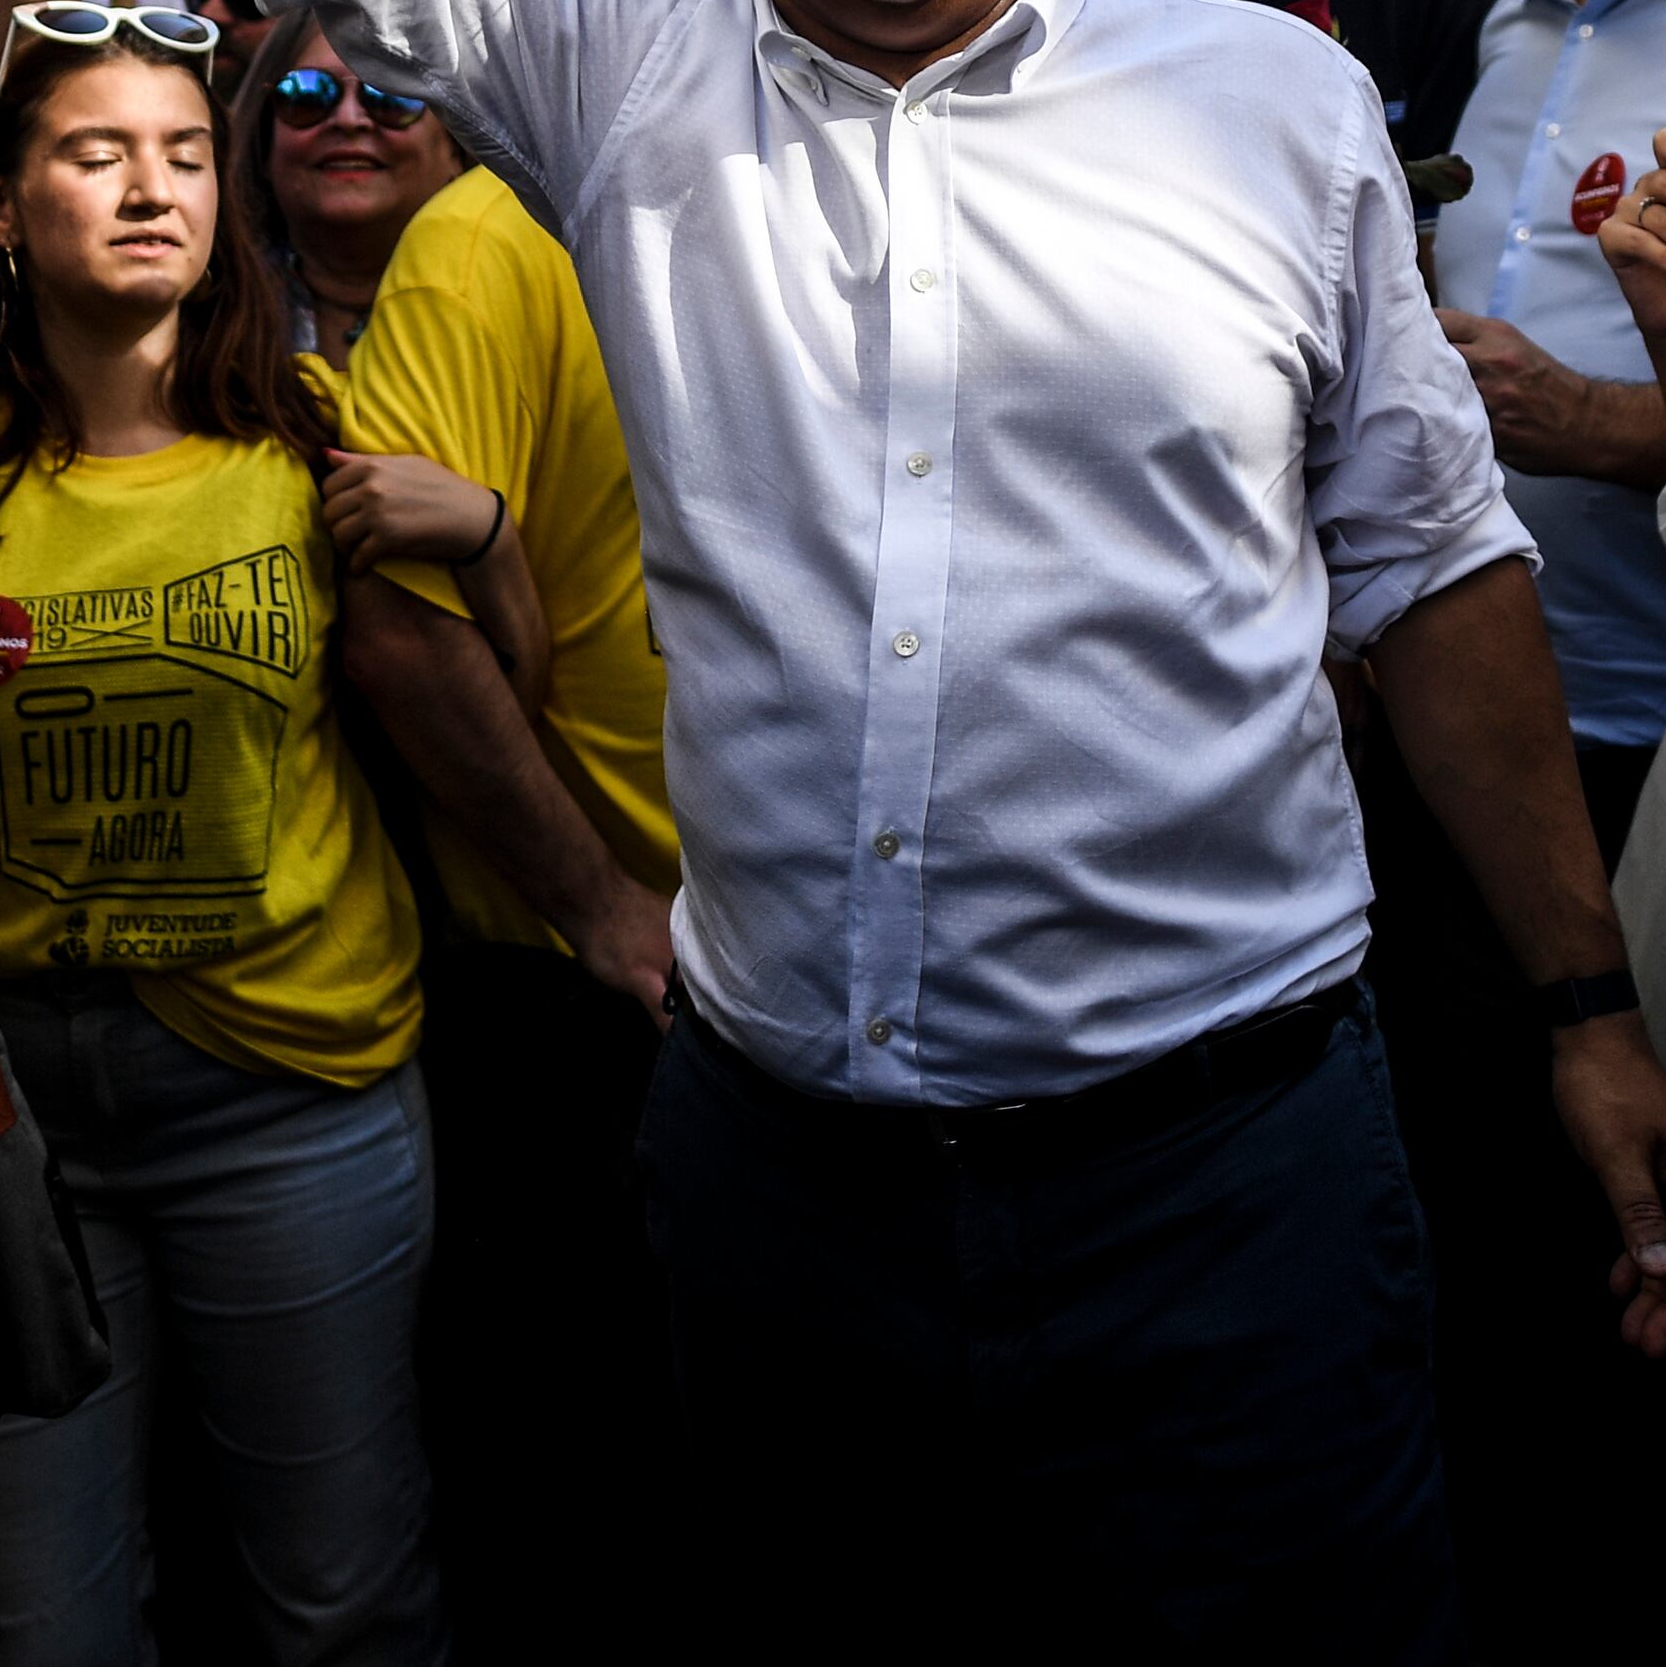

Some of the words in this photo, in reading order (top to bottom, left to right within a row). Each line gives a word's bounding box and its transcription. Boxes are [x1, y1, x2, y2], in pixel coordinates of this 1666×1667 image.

[171, 554, 288, 614] #FAZ-TE
[32, 627, 68, 653] 19
[189, 610, 293, 669] OUVIR
[22, 718, 192, 805] FUTURO
[88, 810, 185, 867] AGORA
[105, 912, 237, 937] JUVENTUDE
